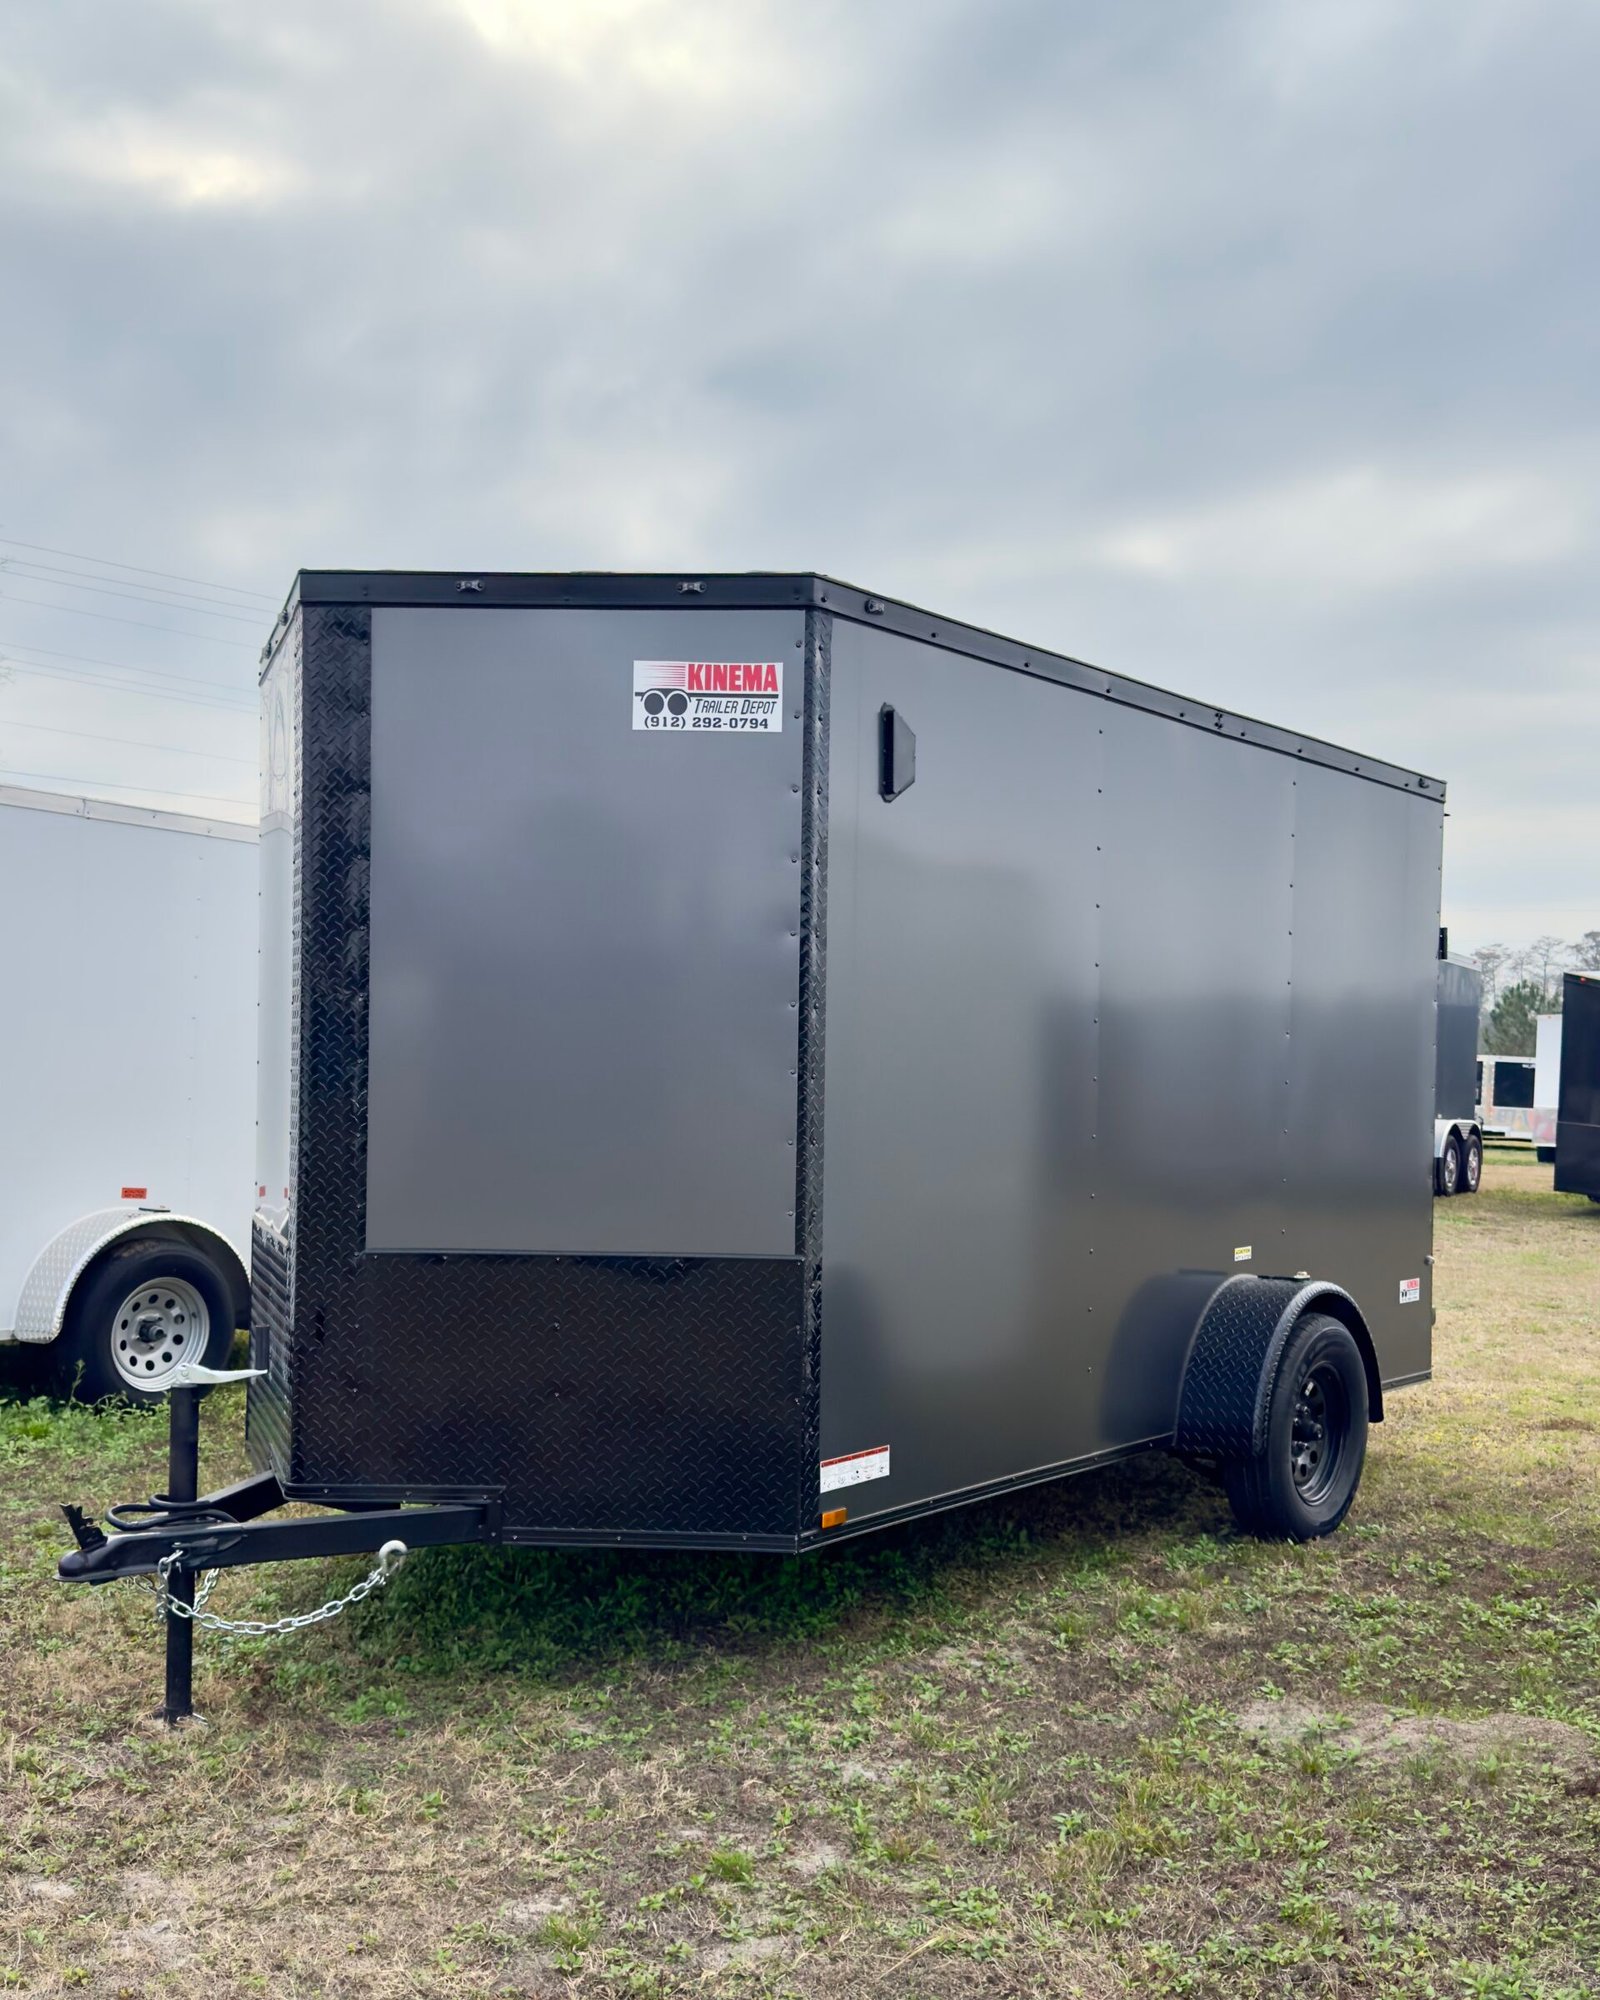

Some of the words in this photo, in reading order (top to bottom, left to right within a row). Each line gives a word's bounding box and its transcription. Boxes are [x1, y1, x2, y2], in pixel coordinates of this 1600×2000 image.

[688, 664, 778, 692] KINEMA
[695, 699, 739, 714] TRAILER
[741, 699, 777, 715] DEPOT
[644, 716, 686, 729] (912)
[692, 717, 768, 729] 292-0794
